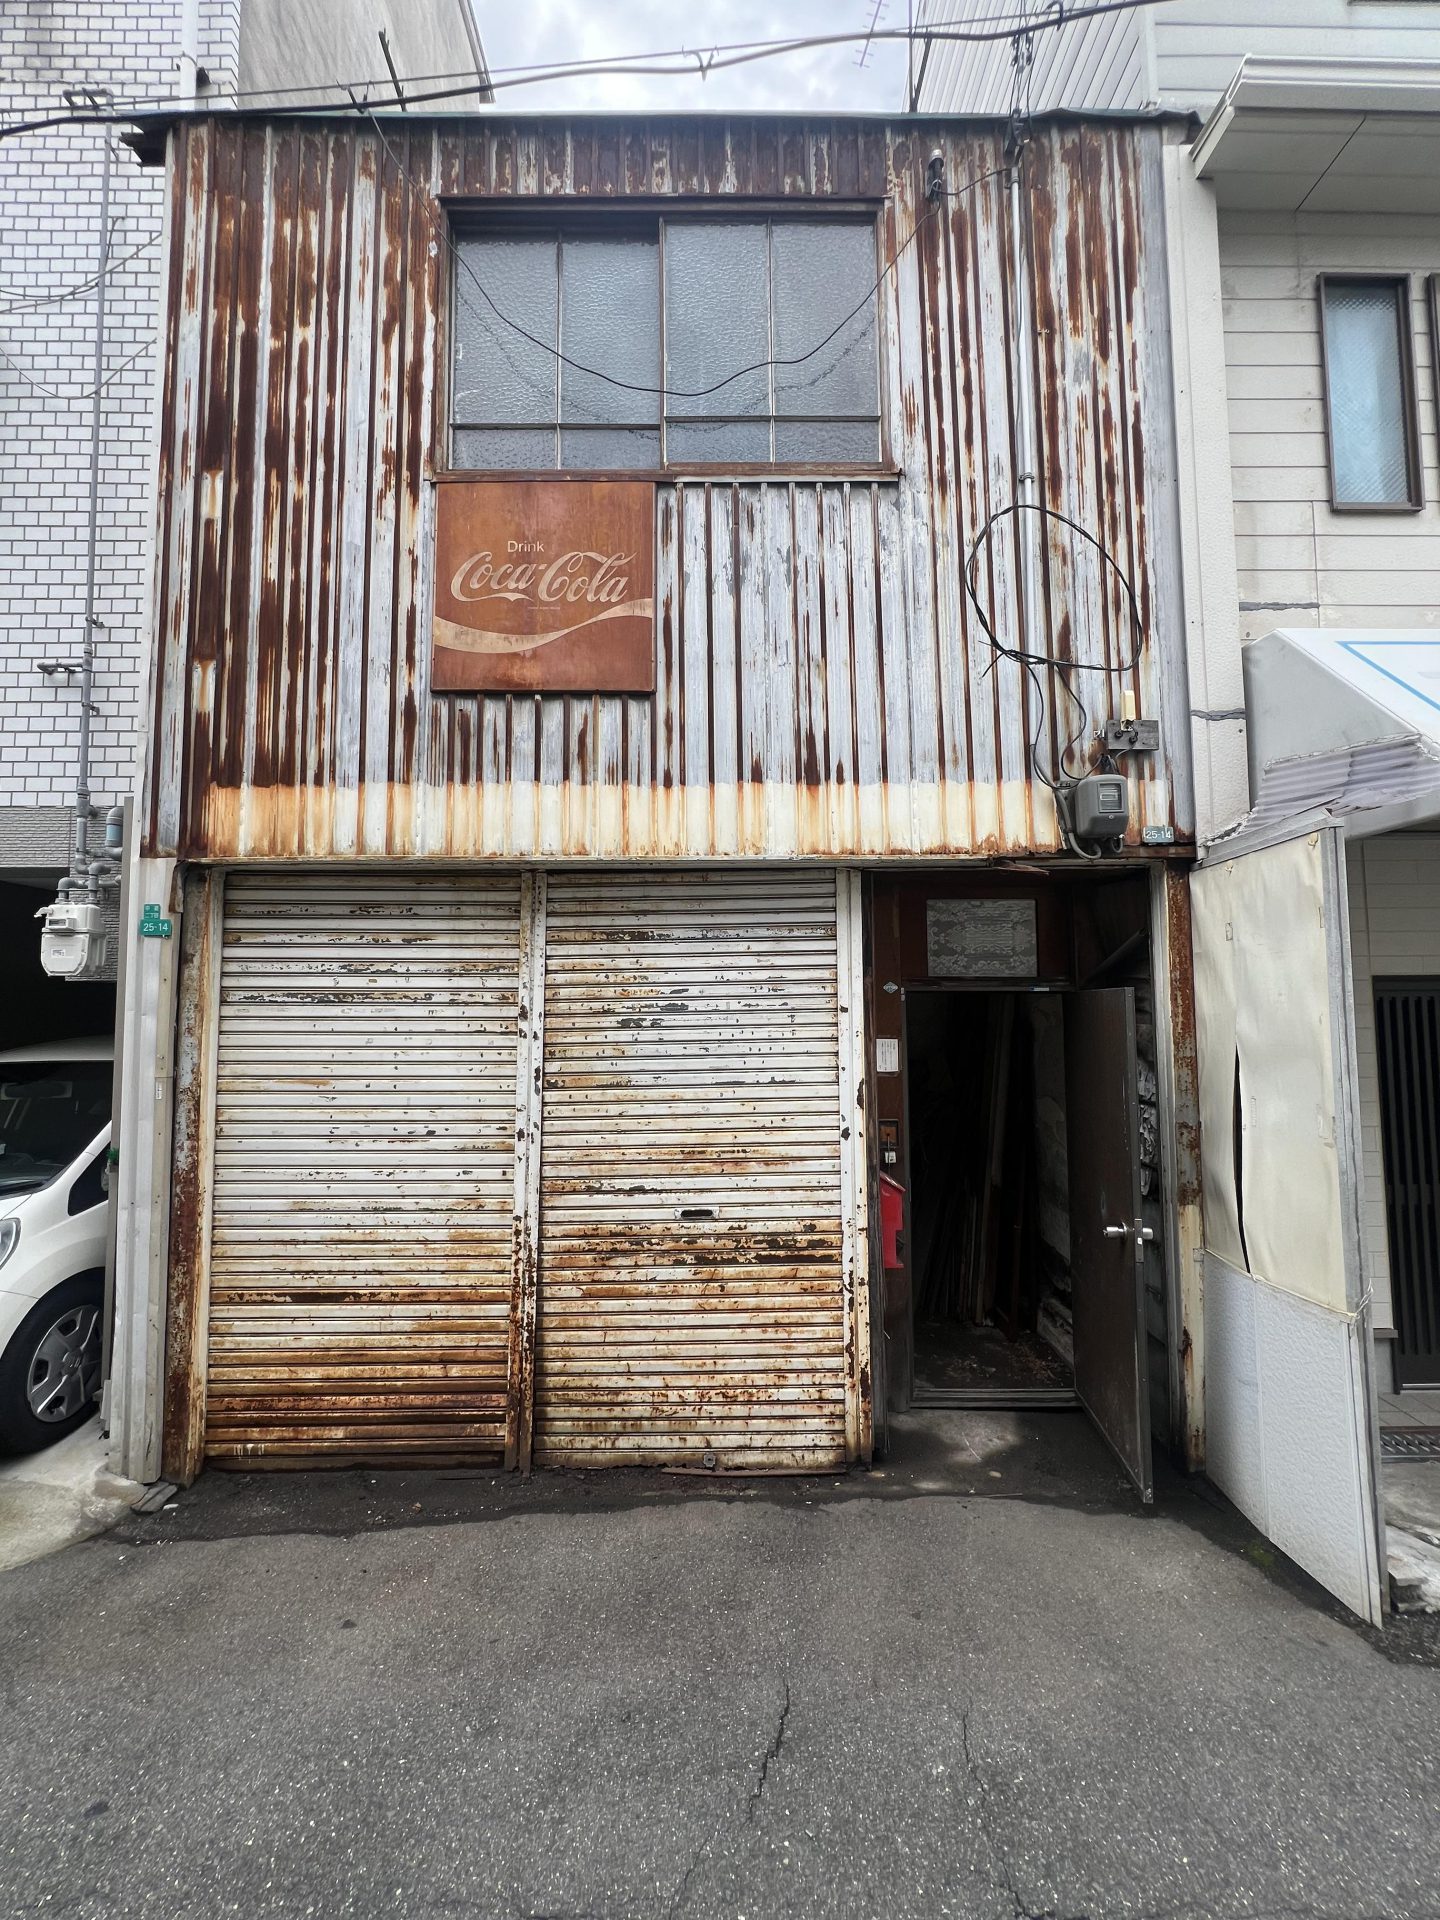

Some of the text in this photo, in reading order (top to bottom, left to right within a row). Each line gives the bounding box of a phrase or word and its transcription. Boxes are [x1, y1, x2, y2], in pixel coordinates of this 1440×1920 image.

[507, 541, 545, 552] Drink
[451, 552, 637, 602] Coca-Cola
[1146, 830, 1171, 838] 25-14
[143, 923, 169, 932] 25-14
